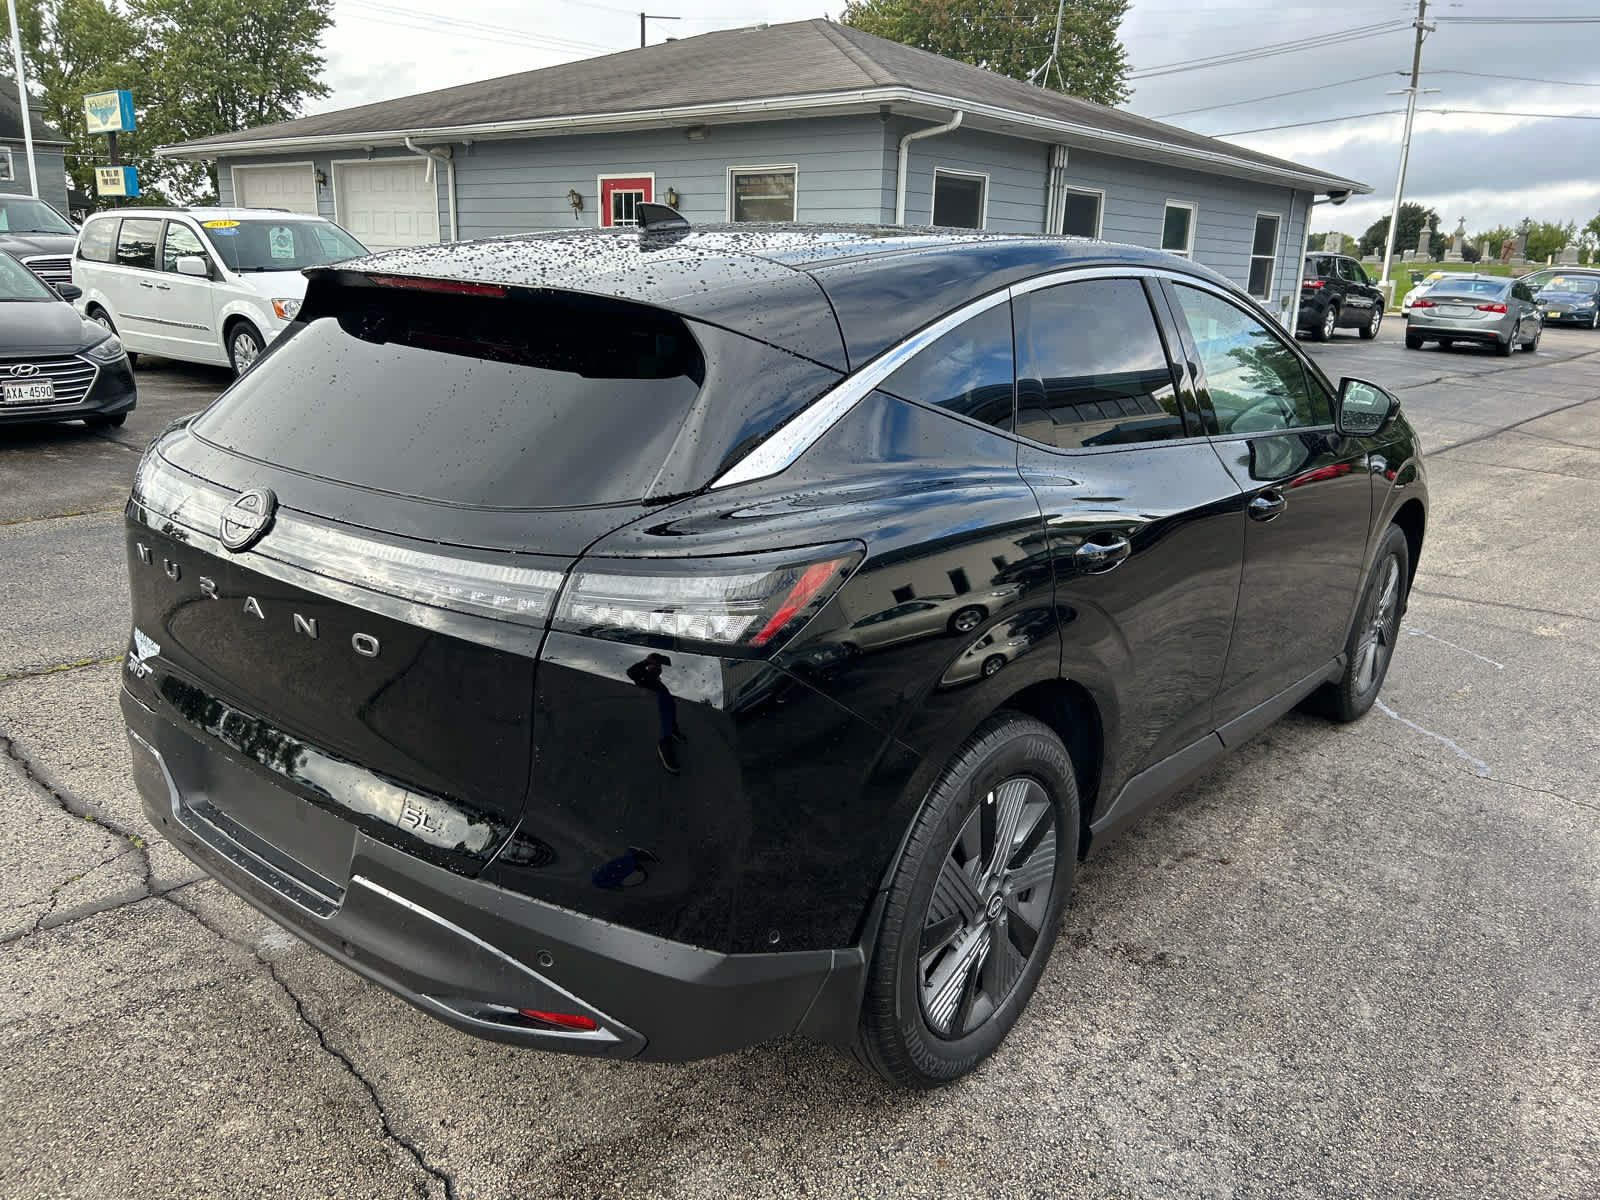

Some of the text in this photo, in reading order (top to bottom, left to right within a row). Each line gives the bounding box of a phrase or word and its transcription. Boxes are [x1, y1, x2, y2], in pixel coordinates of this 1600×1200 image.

[6, 386, 52, 399] AXA-4590
[136, 542, 381, 658] MURANO
[401, 807, 436, 833] SL
